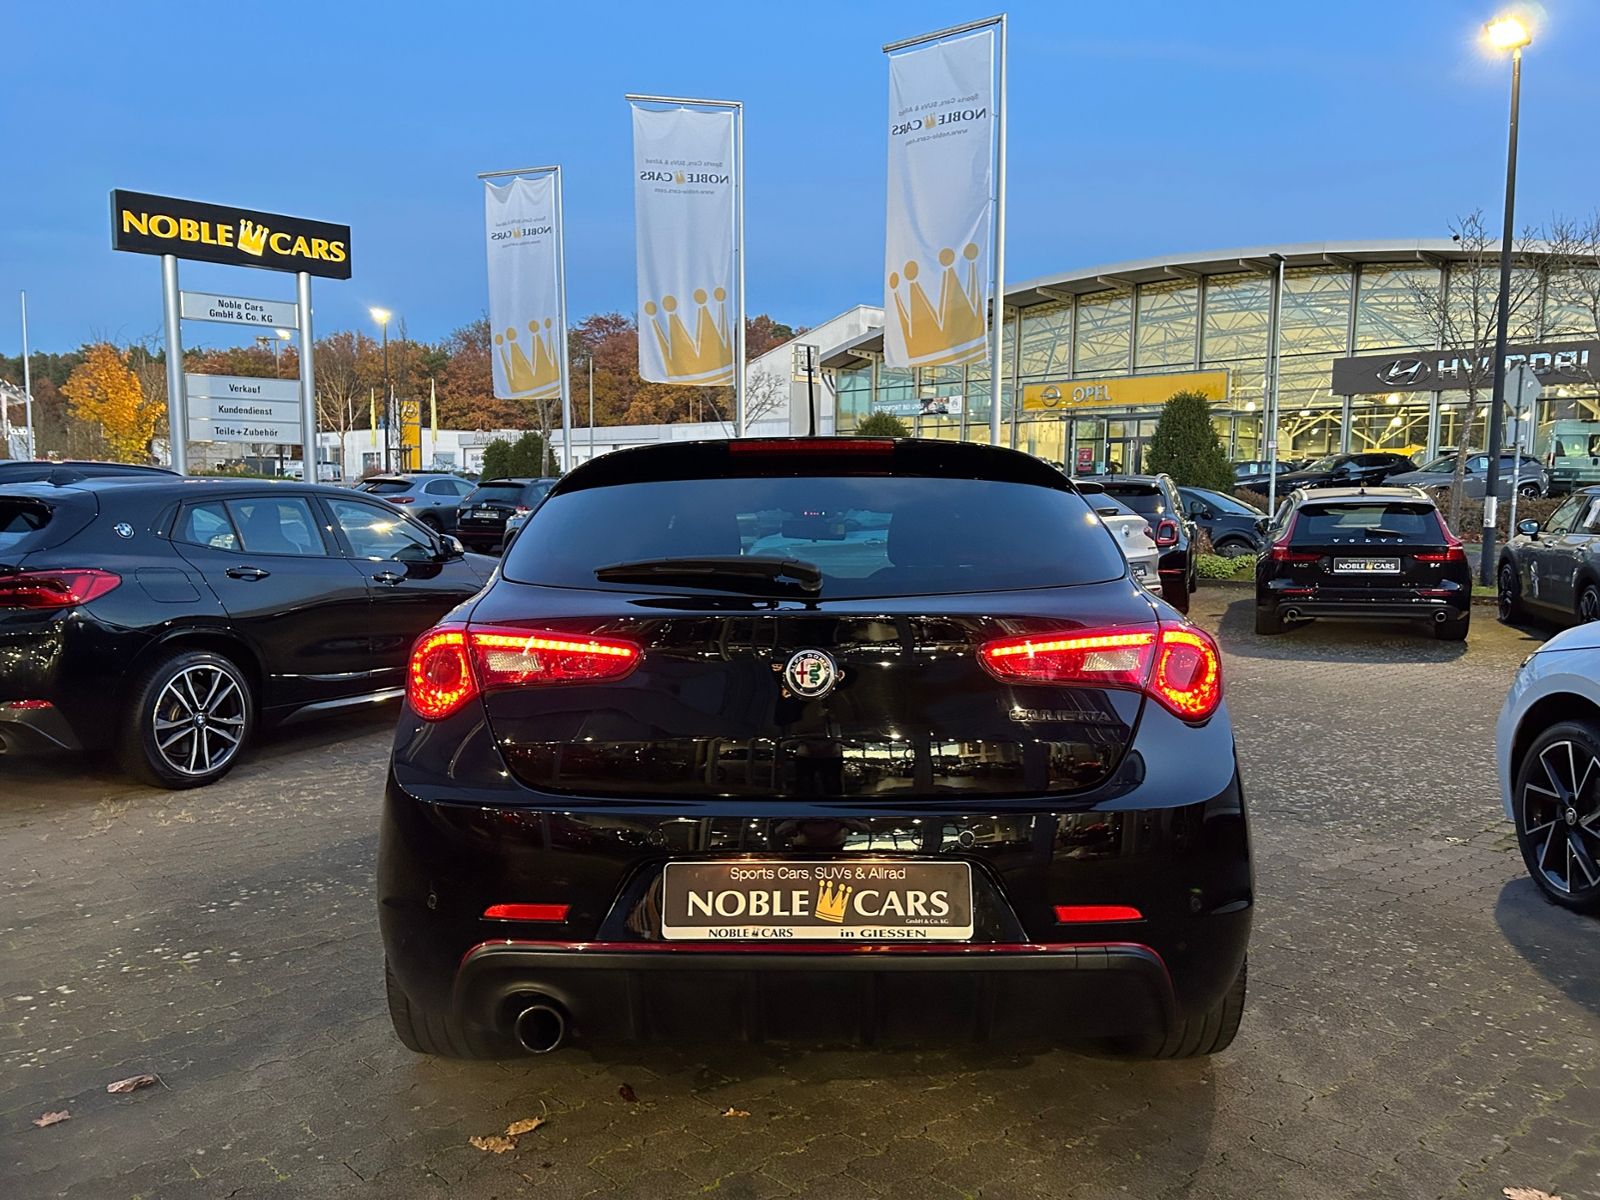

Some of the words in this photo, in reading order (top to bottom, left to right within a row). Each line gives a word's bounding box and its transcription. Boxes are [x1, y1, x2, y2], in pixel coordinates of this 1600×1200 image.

[122, 209, 234, 247] NOBLE
[269, 232, 346, 262] CARS
[218, 299, 242, 310] Noble
[244, 302, 264, 311] Cars
[209, 309, 234, 319] GmbH
[236, 312, 243, 320] &
[245, 312, 259, 322] Co.
[261, 314, 273, 323] KG
[229, 384, 261, 394] Verkauf
[1072, 385, 1112, 402] OPEL
[218, 405, 272, 416] Kundendienst
[214, 426, 278, 437] Teile+Zubehör
[730, 867, 775, 882] Sports
[777, 866, 813, 881] Cars,
[814, 867, 852, 880] SUVs
[854, 867, 866, 880] &
[868, 867, 907, 880] Allrad
[687, 890, 810, 917] NOBLE
[853, 890, 950, 917] CARS
[708, 928, 749, 938] NOBLE
[761, 928, 794, 938] CARS
[840, 928, 855, 938] in
[860, 928, 927, 938] GIESSEN
